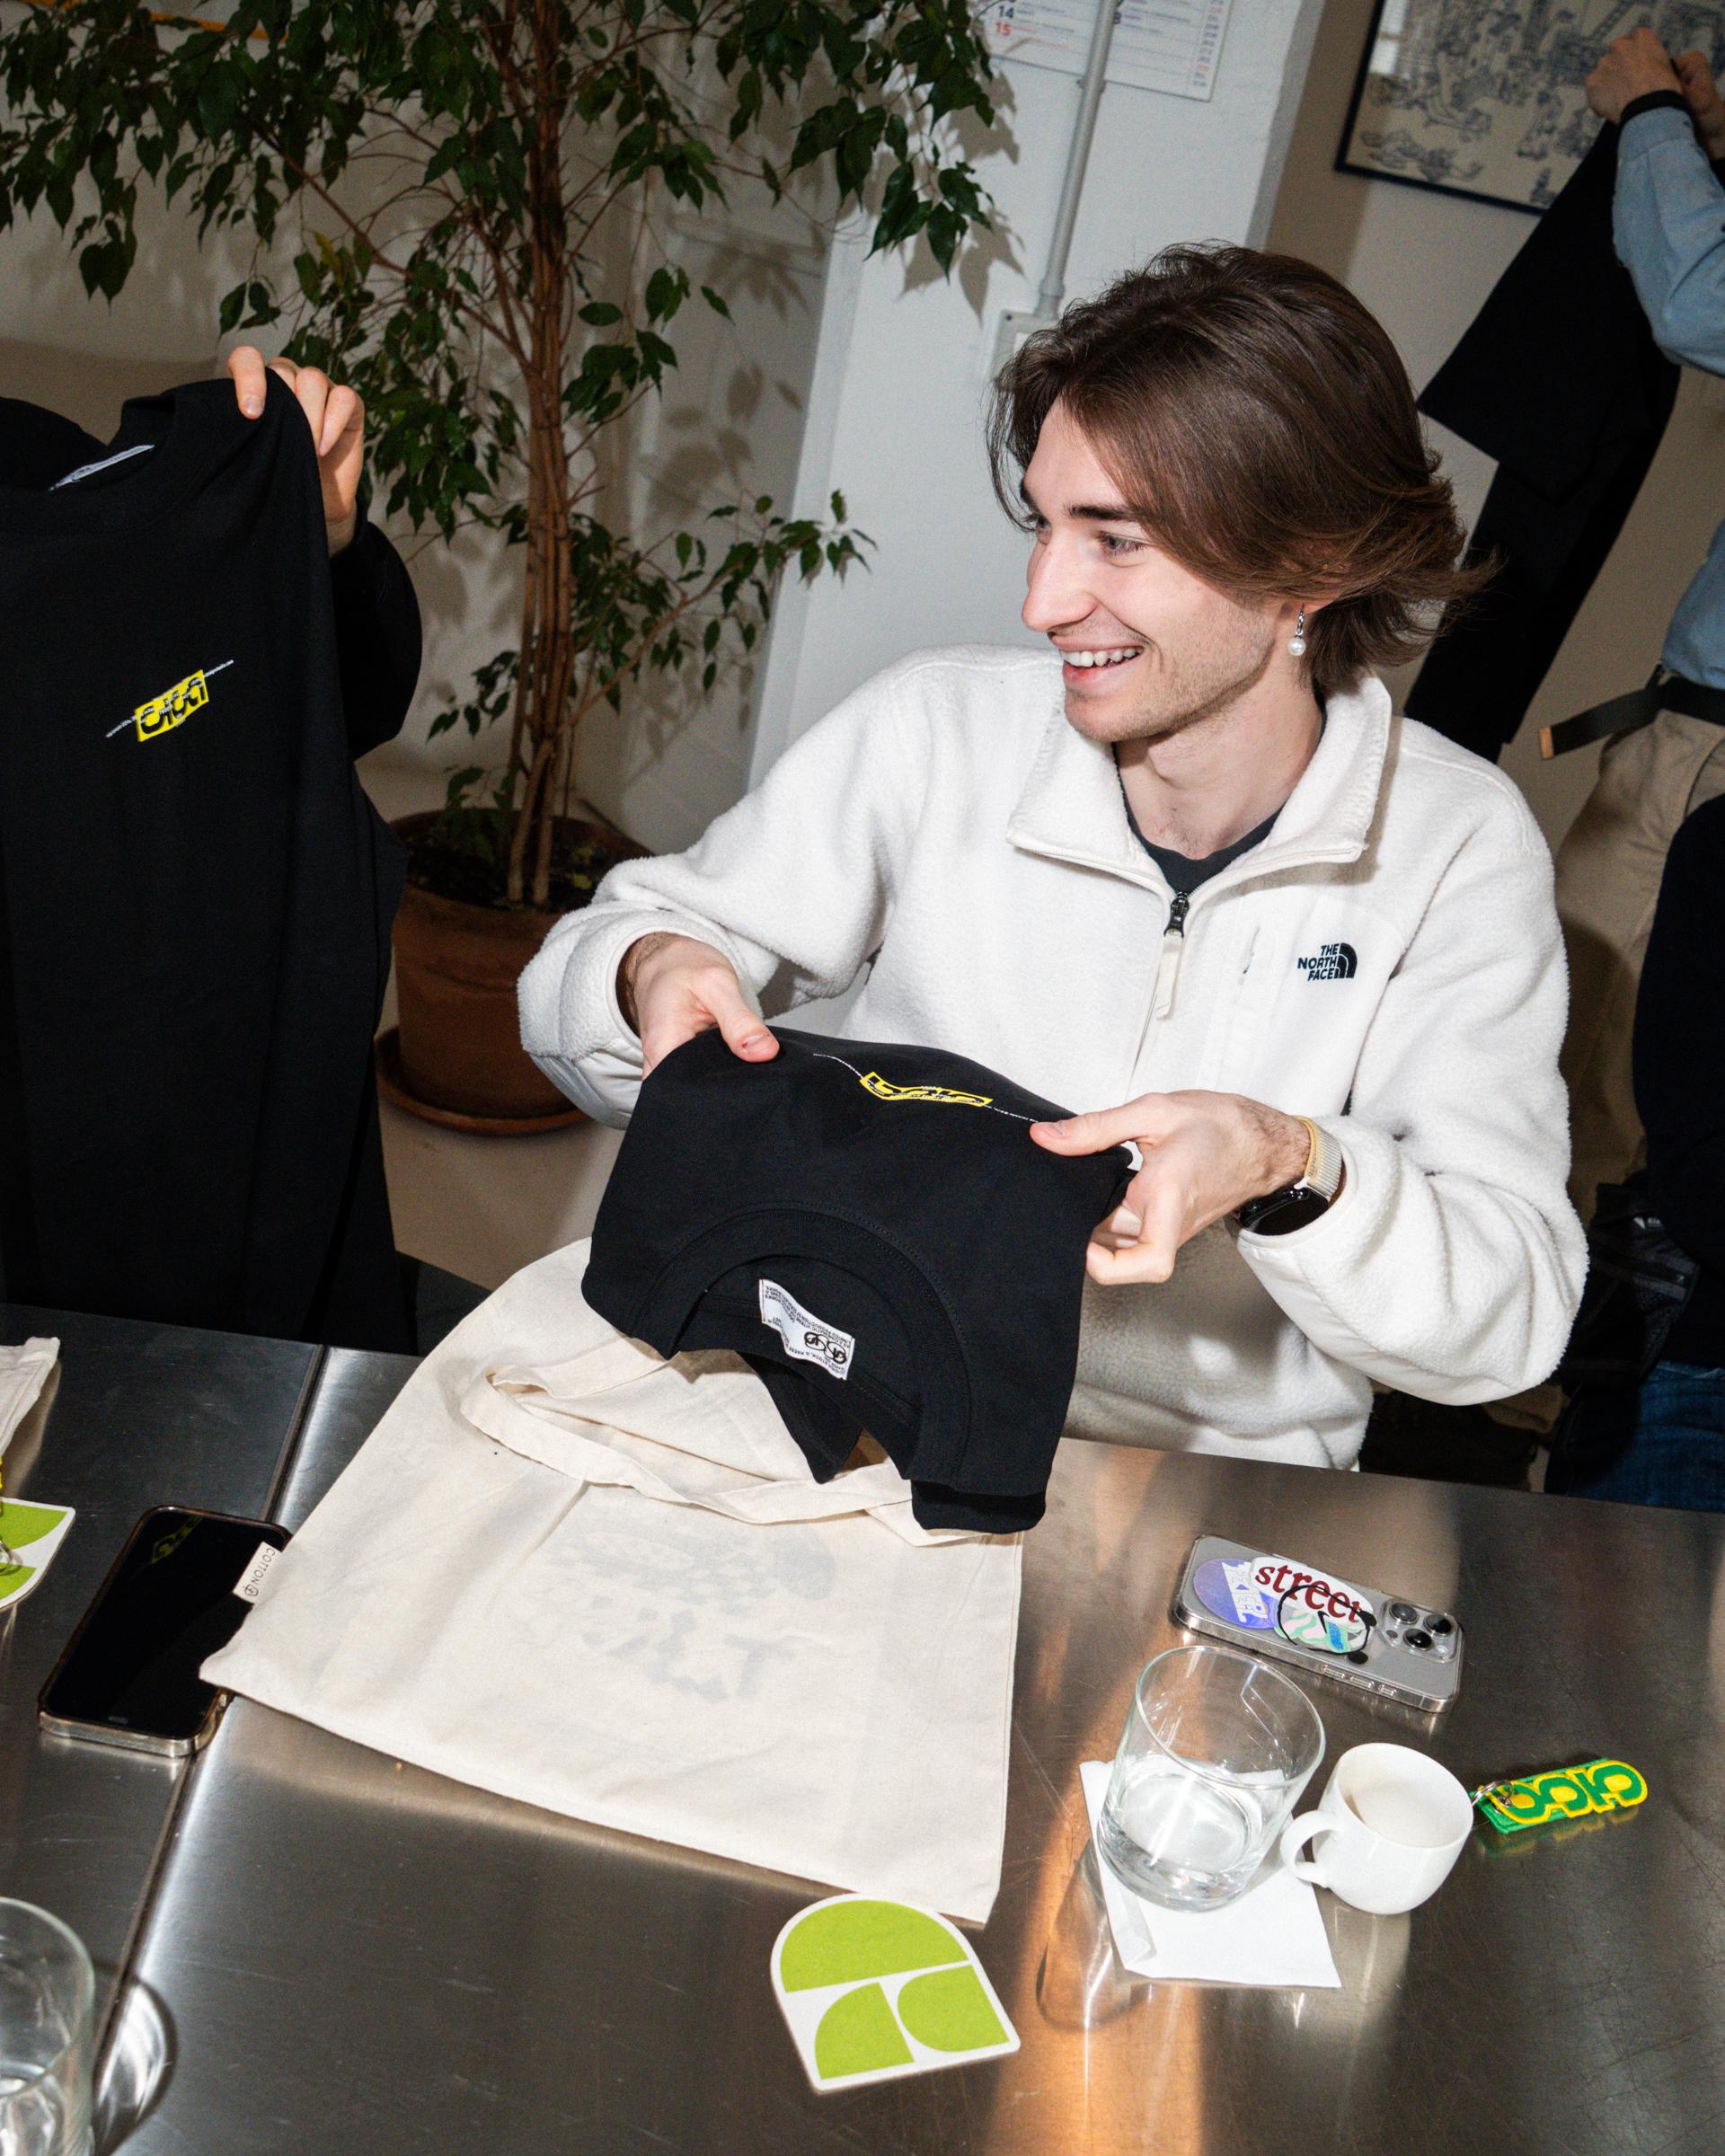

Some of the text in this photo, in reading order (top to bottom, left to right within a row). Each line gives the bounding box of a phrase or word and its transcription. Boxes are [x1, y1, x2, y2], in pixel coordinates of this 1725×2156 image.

[998, 5, 1014, 20] 14
[995, 22, 1013, 37] 15
[1321, 943, 1340, 957] THE
[1297, 955, 1338, 970] NORTH
[1307, 968, 1335, 981] FACE
[252, 1548, 276, 1585] COTTON
[1255, 1564, 1362, 1623] street
